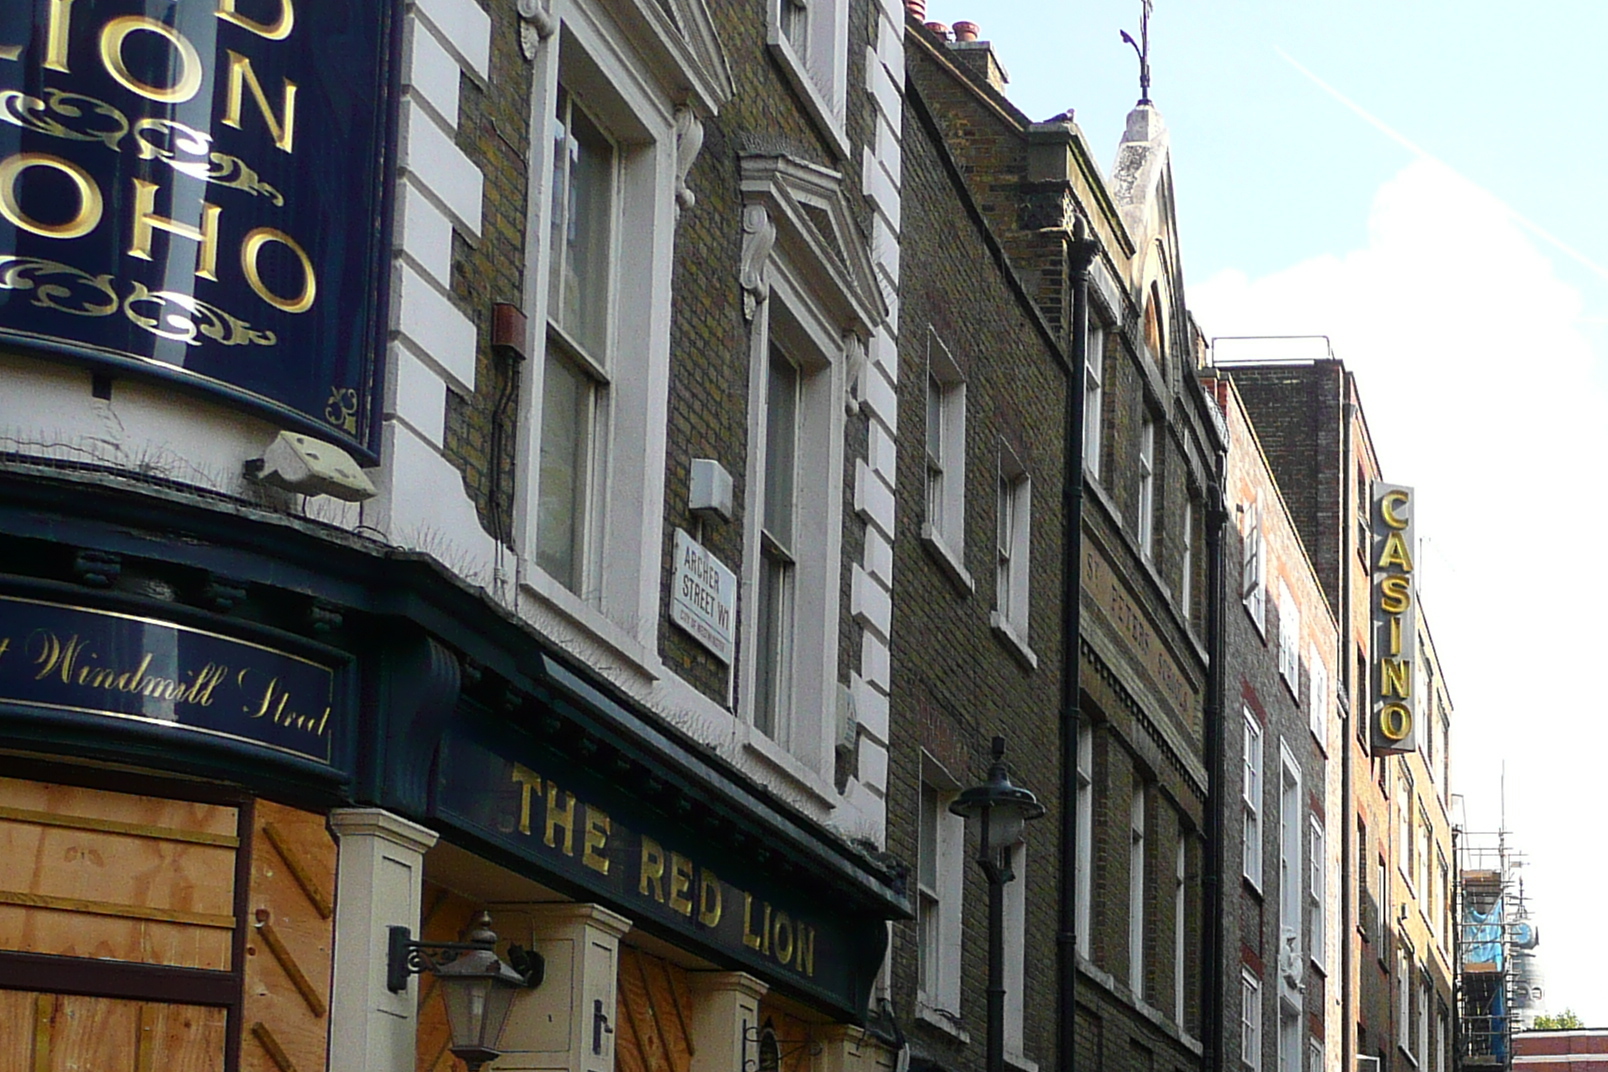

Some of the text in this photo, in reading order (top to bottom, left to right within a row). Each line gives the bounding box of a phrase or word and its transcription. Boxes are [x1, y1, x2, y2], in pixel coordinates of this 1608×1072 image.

[0, 0, 298, 153] ION
[682, 574, 730, 631] STREET W1
[684, 545, 720, 595] ARCHER
[1378, 489, 1413, 740] CASINO
[26, 628, 227, 706] Windmill
[512, 761, 816, 978] THE RED LION
